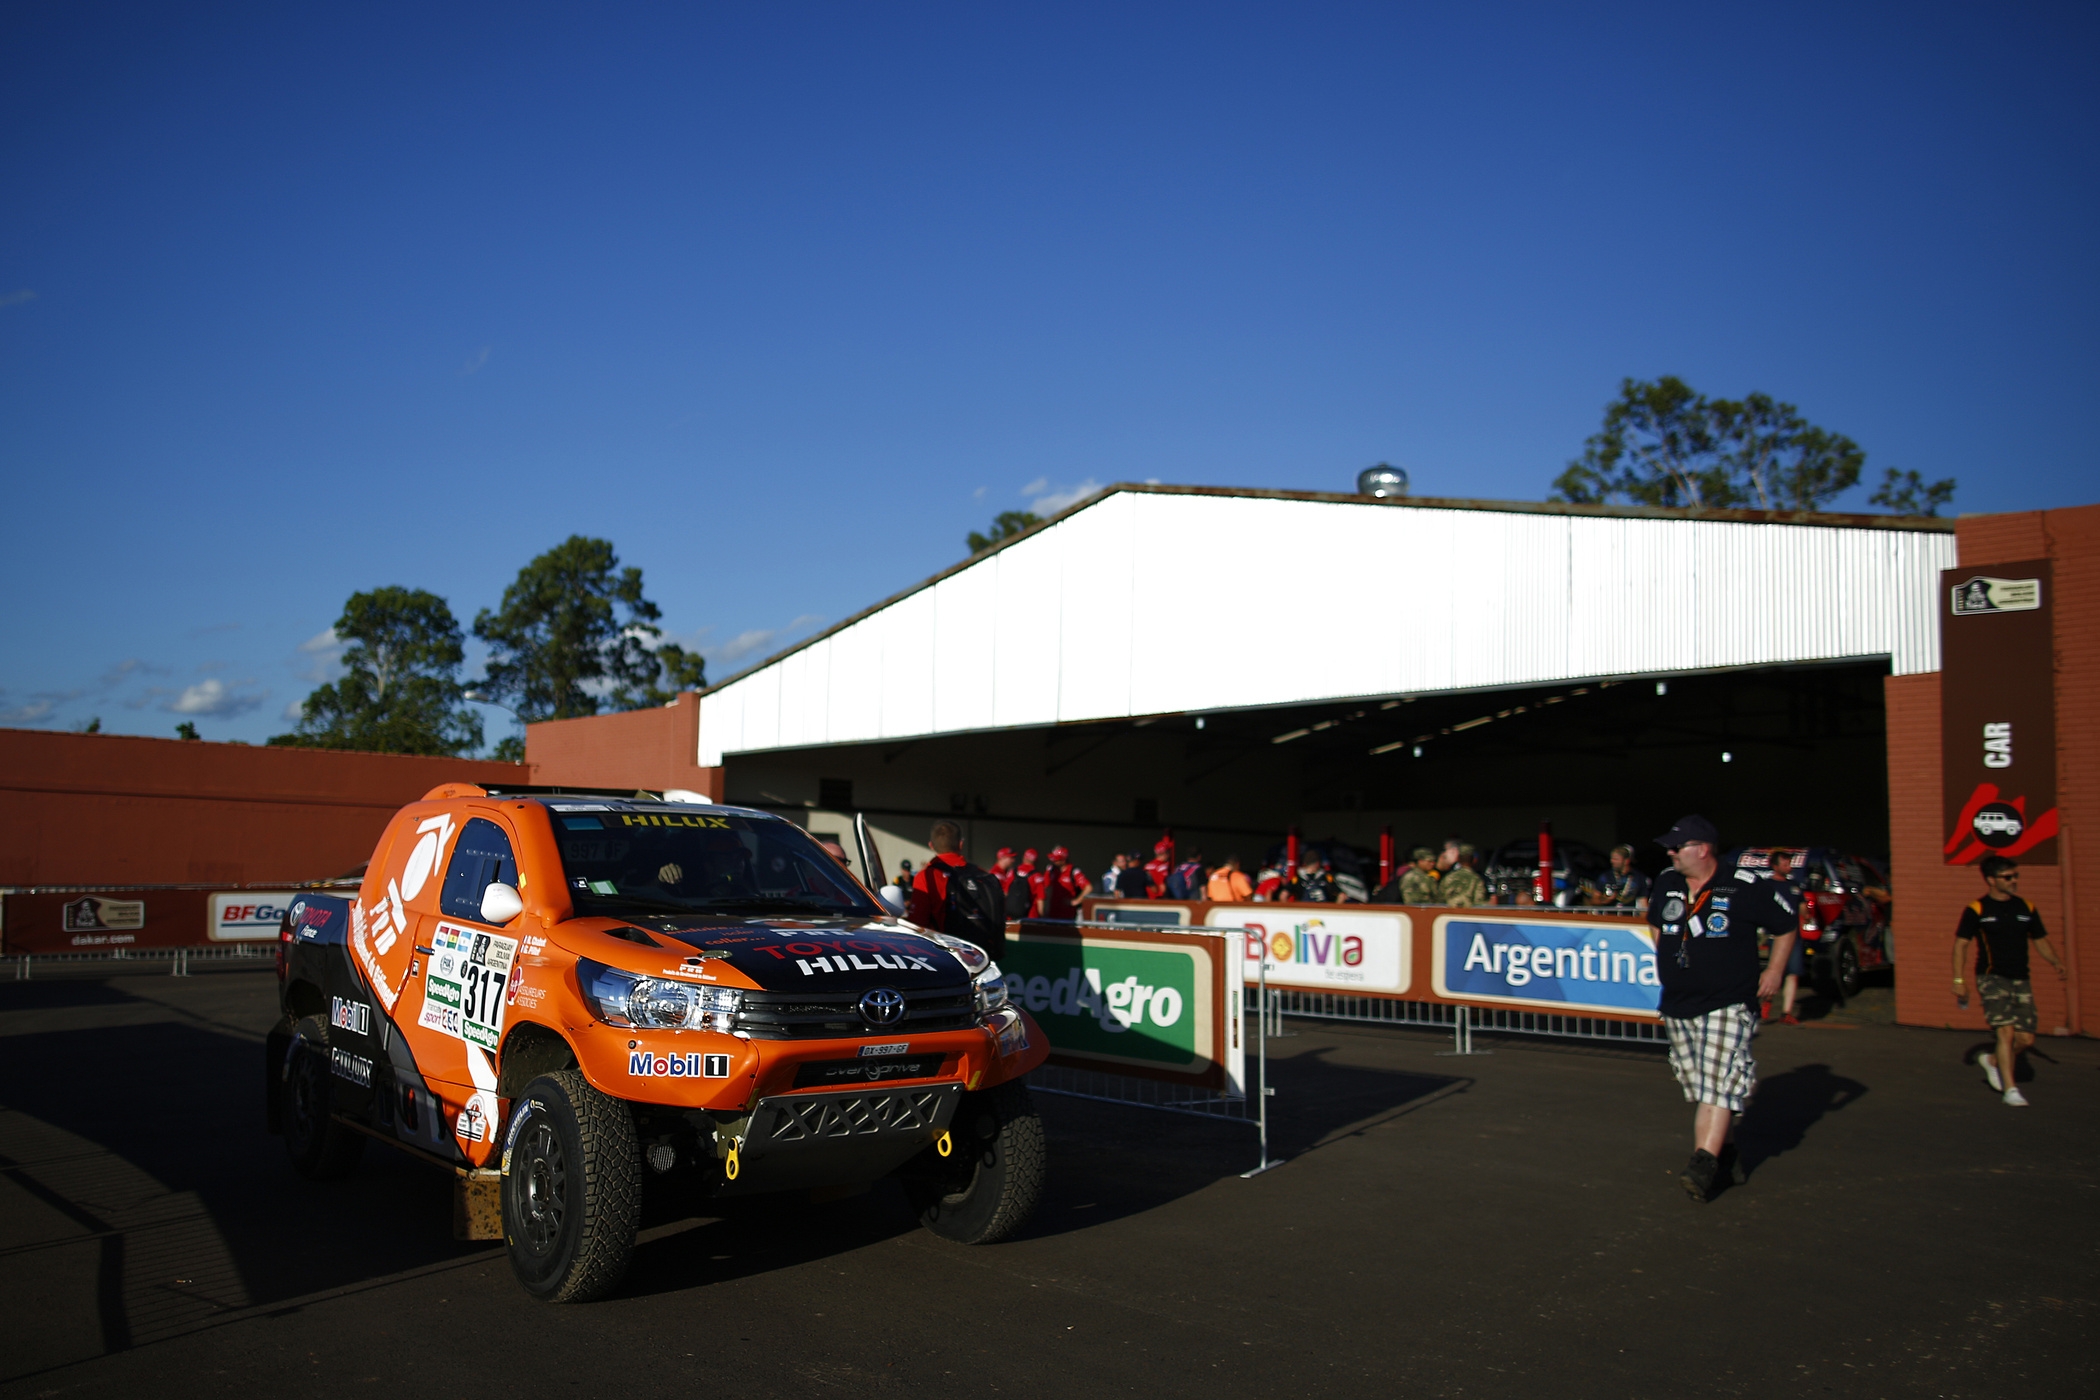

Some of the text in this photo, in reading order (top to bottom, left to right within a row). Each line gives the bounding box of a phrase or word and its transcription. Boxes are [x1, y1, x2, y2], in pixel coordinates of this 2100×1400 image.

[1984, 722, 2013, 769] CAR
[621, 815, 731, 830] HILUX
[301, 906, 332, 928] TOYOTA
[71, 934, 136, 946] dakar.com
[752, 940, 938, 961] TOYOTA
[1243, 922, 1363, 967] Bolivia
[795, 954, 938, 976] HILUX
[1463, 932, 1662, 987] Argentina
[428, 978, 460, 1003] SpeedAgro
[464, 966, 506, 1027] 317
[332, 996, 359, 1033] Mobil
[463, 1020, 498, 1047] SpeedAgro
[331, 1047, 374, 1088] HILUX
[631, 1052, 699, 1077] Mobil
[507, 1104, 528, 1146] MICHELIN
